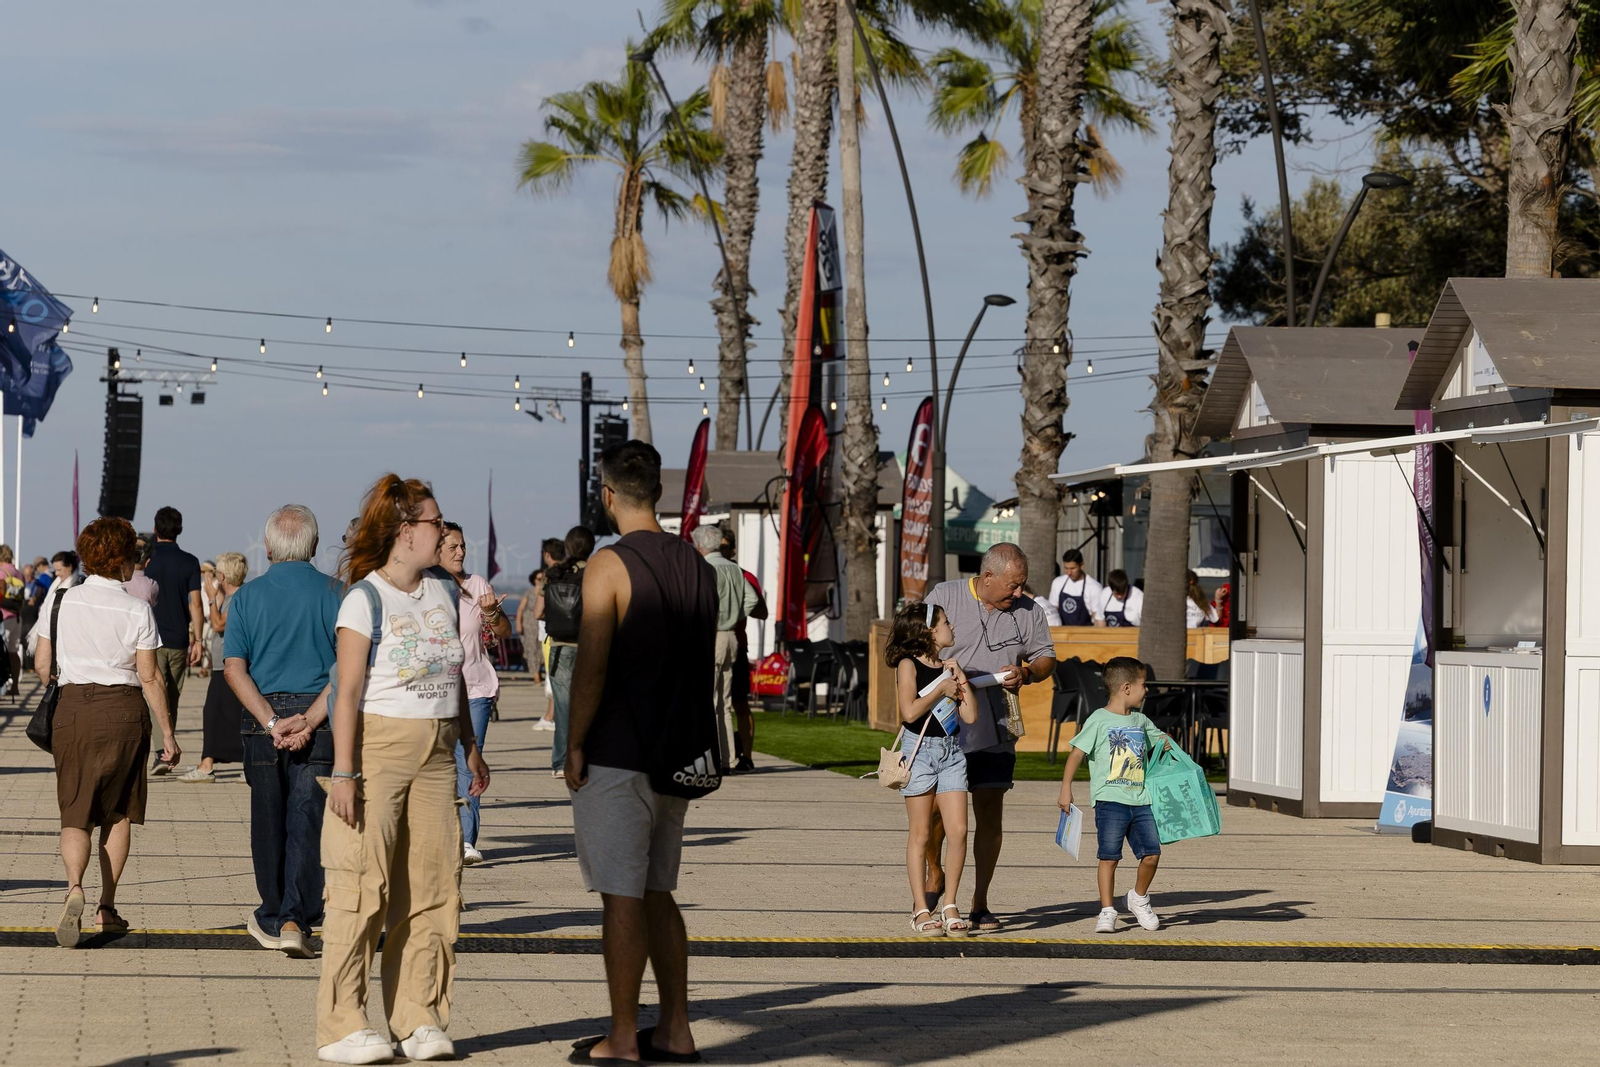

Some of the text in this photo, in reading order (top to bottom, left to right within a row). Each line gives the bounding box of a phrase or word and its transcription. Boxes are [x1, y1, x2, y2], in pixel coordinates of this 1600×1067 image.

[947, 525, 988, 544] DEPORTE
[991, 528, 1003, 544] DE
[405, 681, 457, 692] HELLO KITTY
[417, 690, 448, 700] WORLD
[672, 771, 720, 788] adidas
[1178, 779, 1204, 829] Twister
